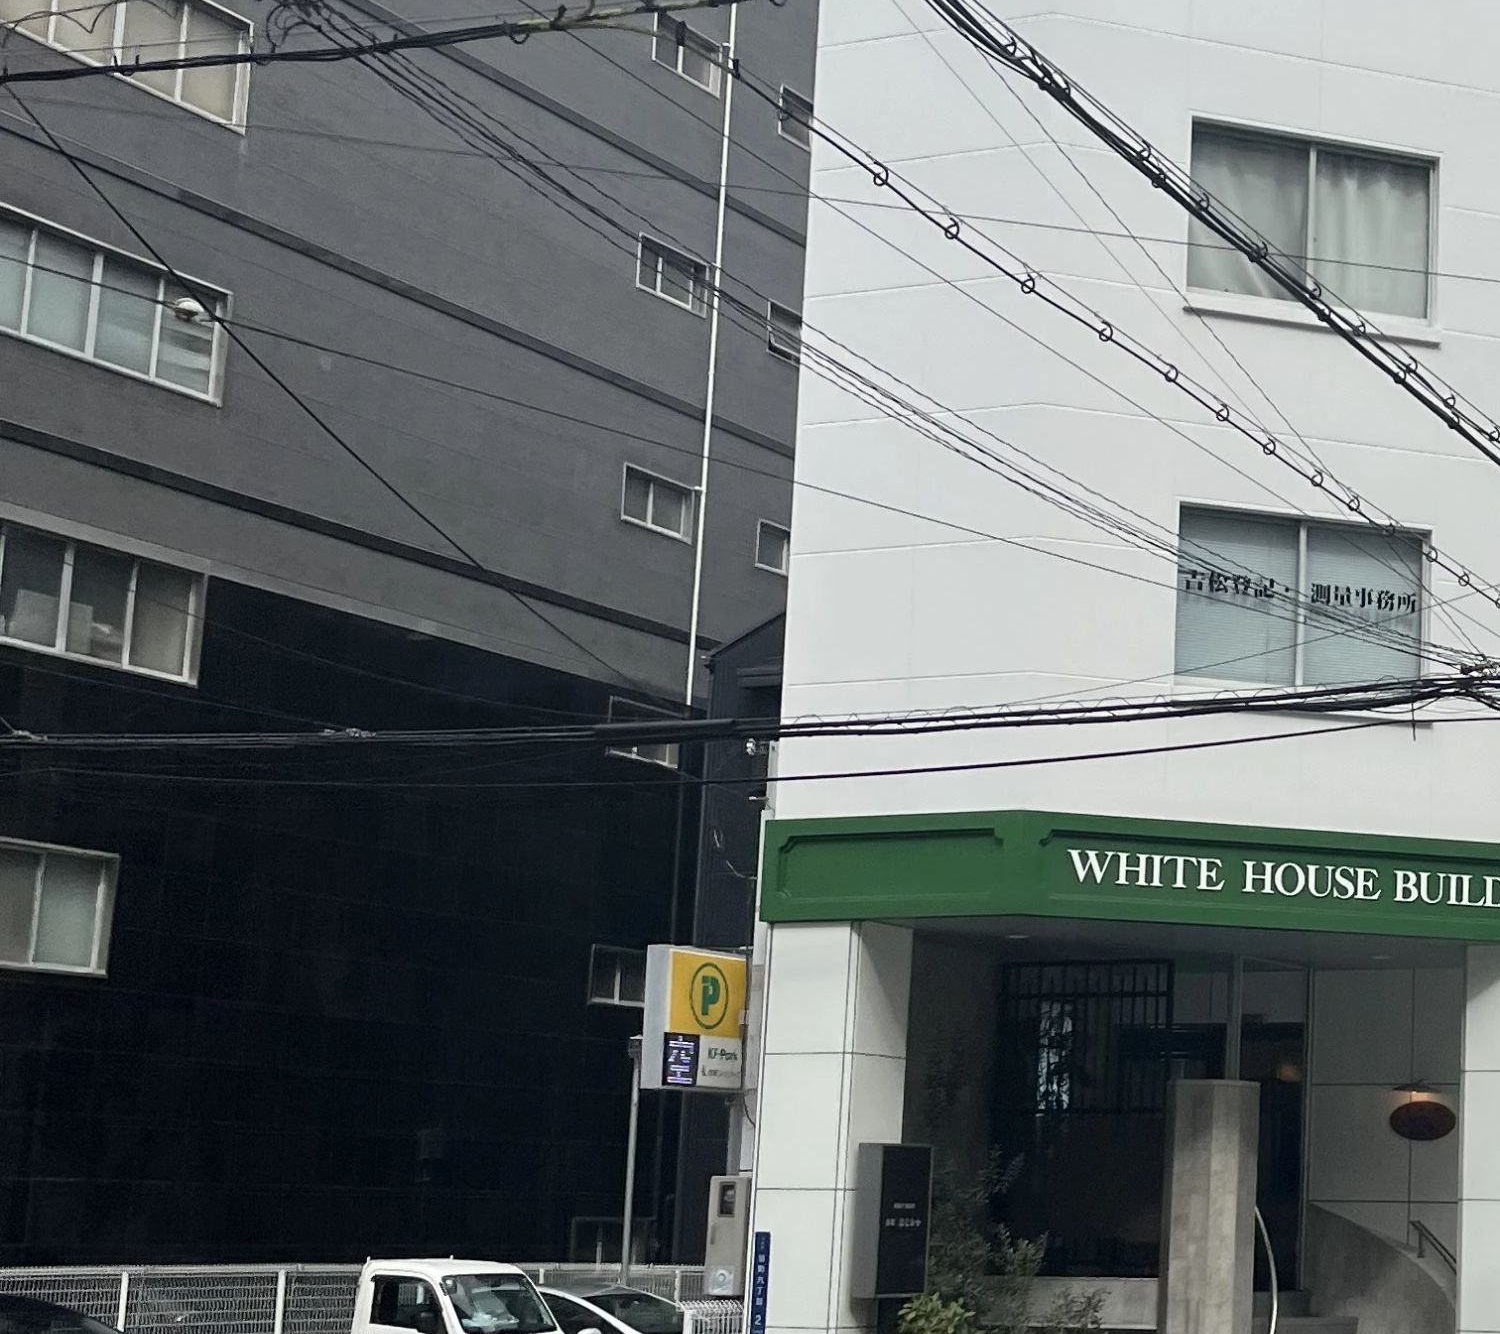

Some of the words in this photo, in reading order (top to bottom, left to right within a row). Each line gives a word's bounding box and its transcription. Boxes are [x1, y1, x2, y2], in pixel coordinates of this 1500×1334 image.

[1067, 848, 1225, 891] WHITE
[1242, 860, 1382, 901] HOUSE
[754, 1314, 762, 1326] 2
